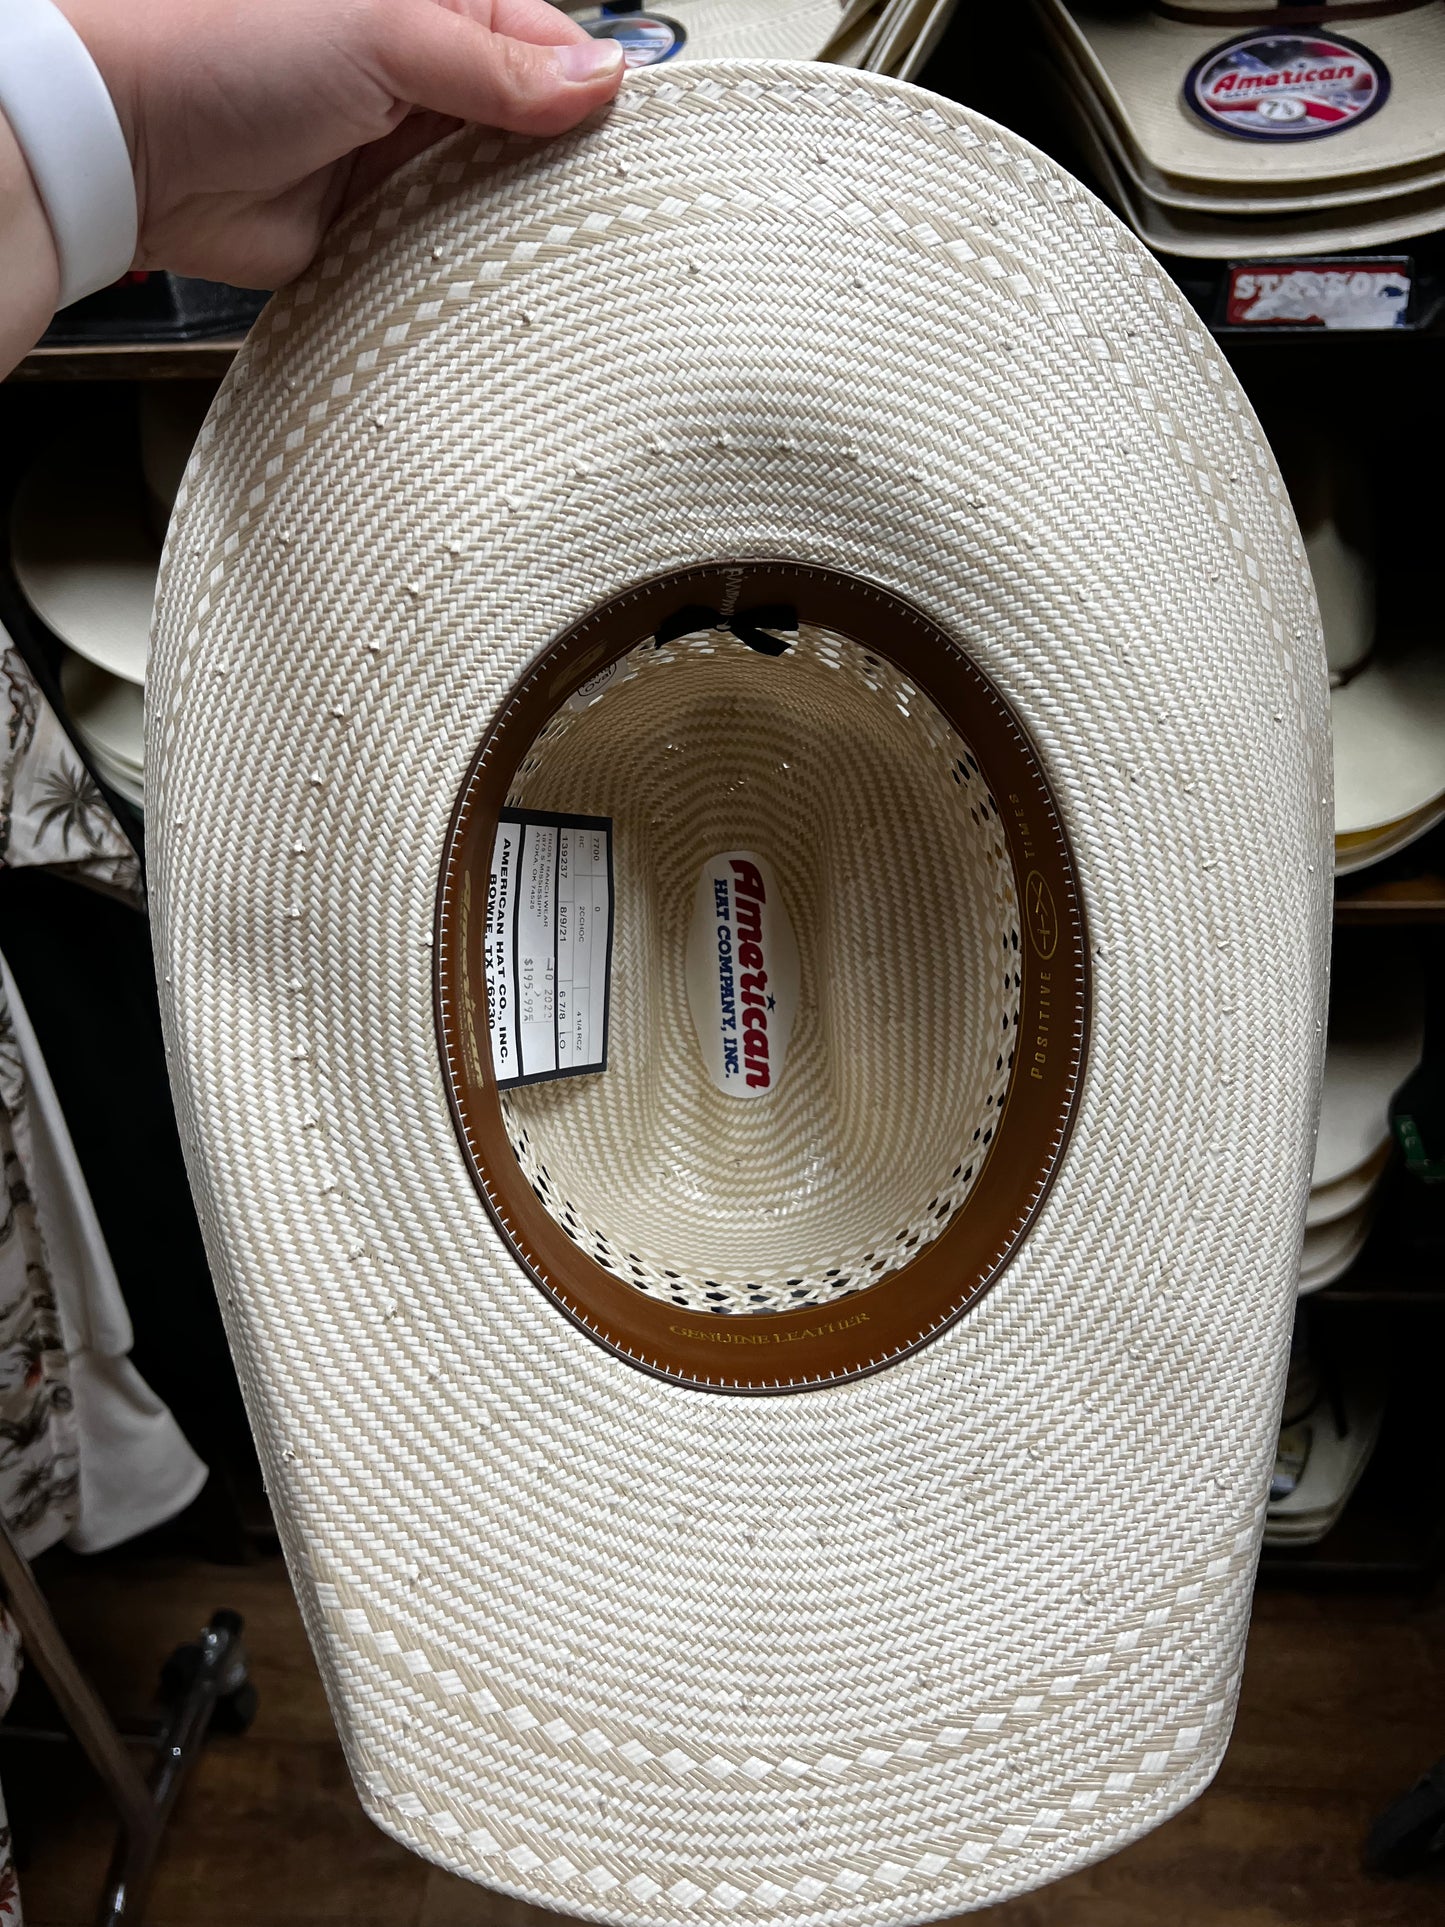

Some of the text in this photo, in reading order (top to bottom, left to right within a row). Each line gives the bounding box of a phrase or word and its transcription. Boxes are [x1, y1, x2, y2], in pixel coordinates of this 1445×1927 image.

[1213, 66, 1355, 95] American
[560, 836, 568, 879] 139237
[592, 837, 600, 861] 7700
[531, 868, 538, 881] OK
[559, 906, 567, 942] 8/9/21
[1009, 793, 1051, 1079] POSITIVE TIMES
[485, 945, 493, 969] TX
[496, 838, 511, 1064] AMERICAN HAT CO., INC.
[714, 878, 740, 1078] HAT COMPANY, INC.
[729, 860, 770, 1089] American
[486, 976, 496, 1029] 76230
[559, 990, 566, 998] 6
[669, 1312, 870, 1344] GENUINE LEATHER
